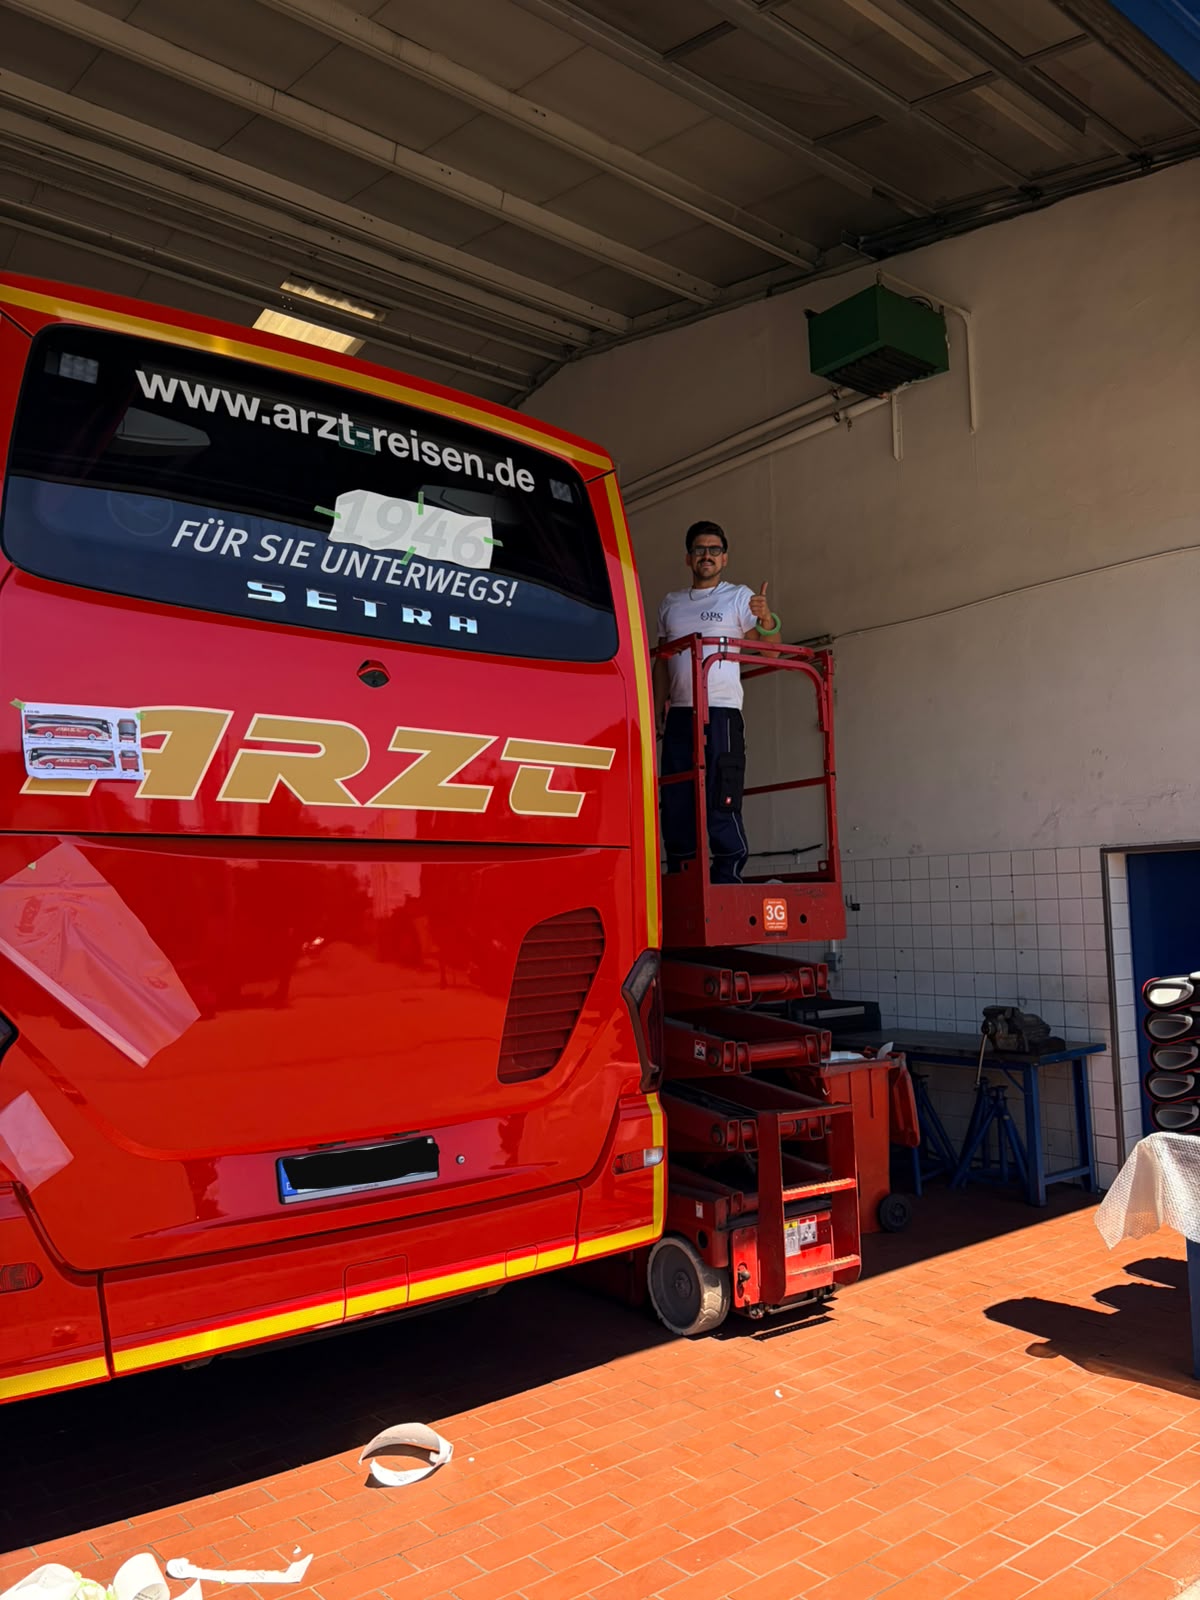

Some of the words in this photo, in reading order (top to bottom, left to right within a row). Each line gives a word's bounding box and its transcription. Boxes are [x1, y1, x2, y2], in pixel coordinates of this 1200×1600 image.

[135, 370, 536, 493] www.arzt-reisen.de
[171, 517, 249, 557] FÜR
[253, 534, 316, 568] SIE
[320, 546, 519, 607] UNTERWEGS!
[330, 491, 489, 565] 1946
[246, 580, 478, 634] SETRA
[766, 904, 785, 921] 3G
